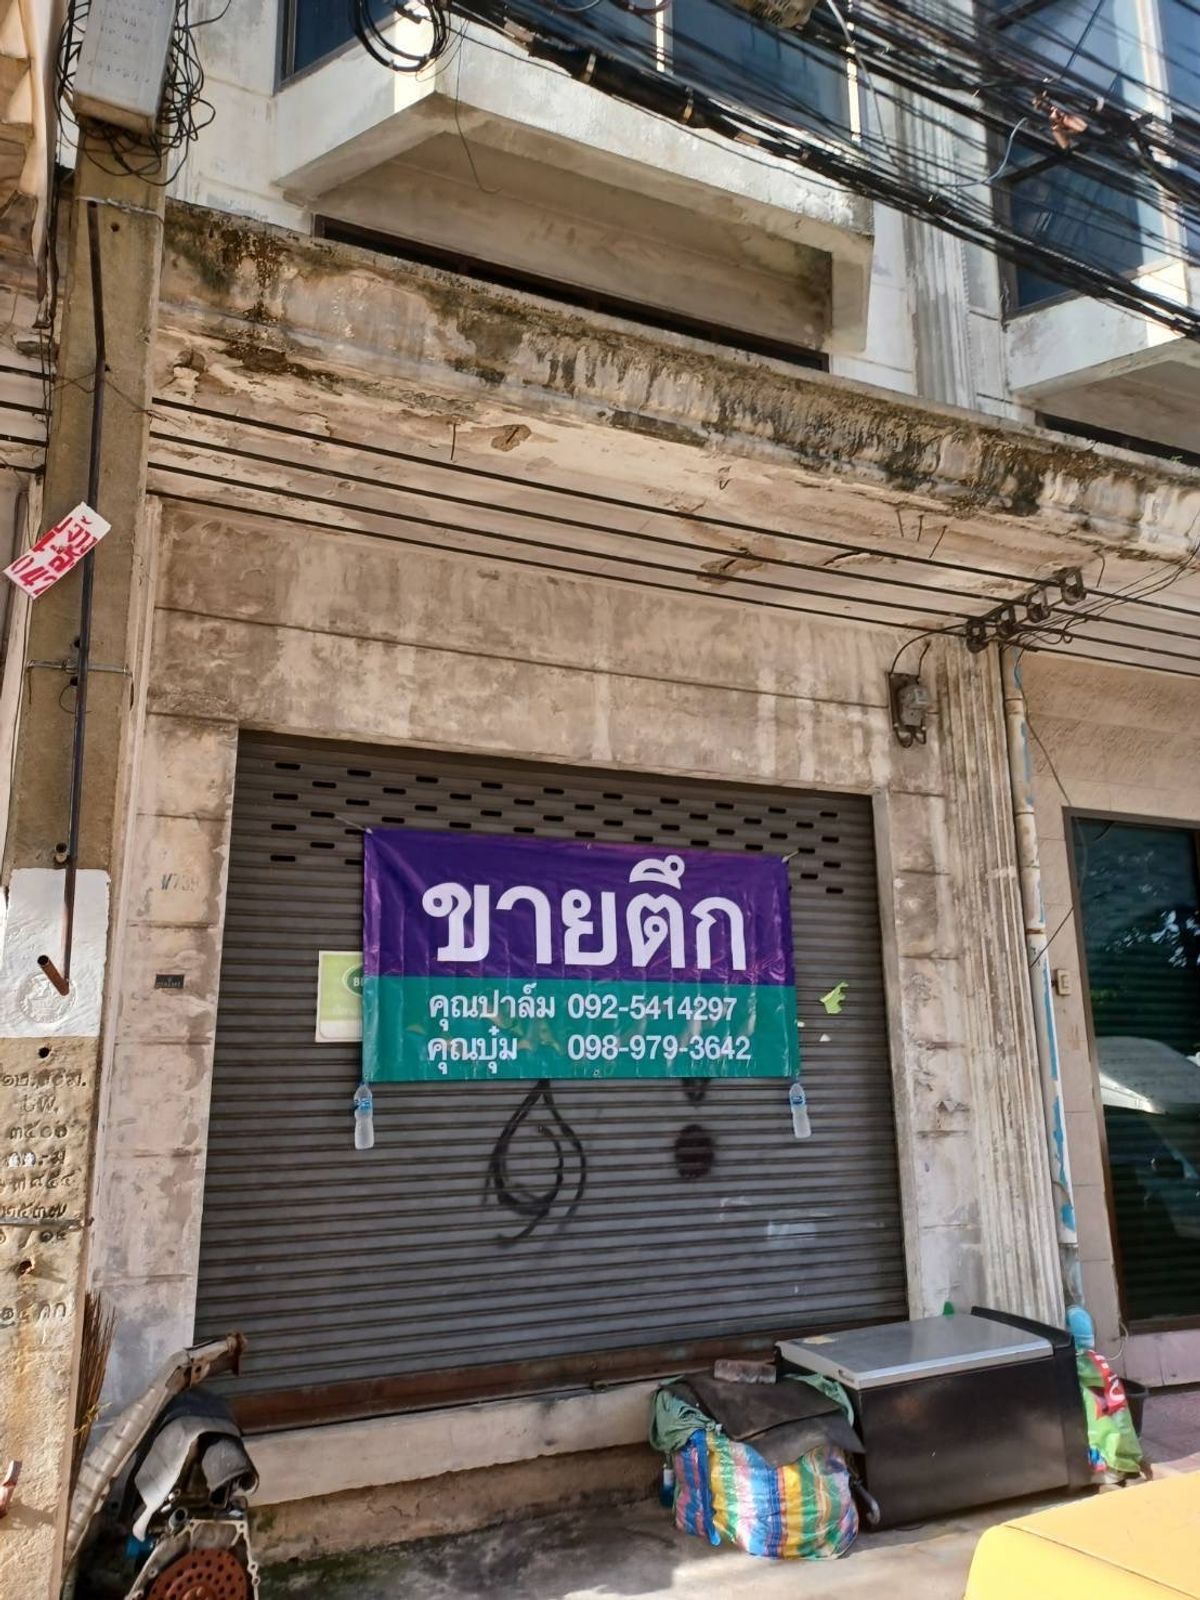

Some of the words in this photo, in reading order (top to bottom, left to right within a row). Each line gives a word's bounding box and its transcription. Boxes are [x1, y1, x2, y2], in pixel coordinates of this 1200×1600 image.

[421, 854, 747, 971] ขายตึก
[428, 983, 555, 1031] คุณปาล์ม
[567, 993, 738, 1021] 092-5414297
[426, 1025, 518, 1076] คุณบุ๋ม
[567, 1034, 753, 1062] 098-979-3642
